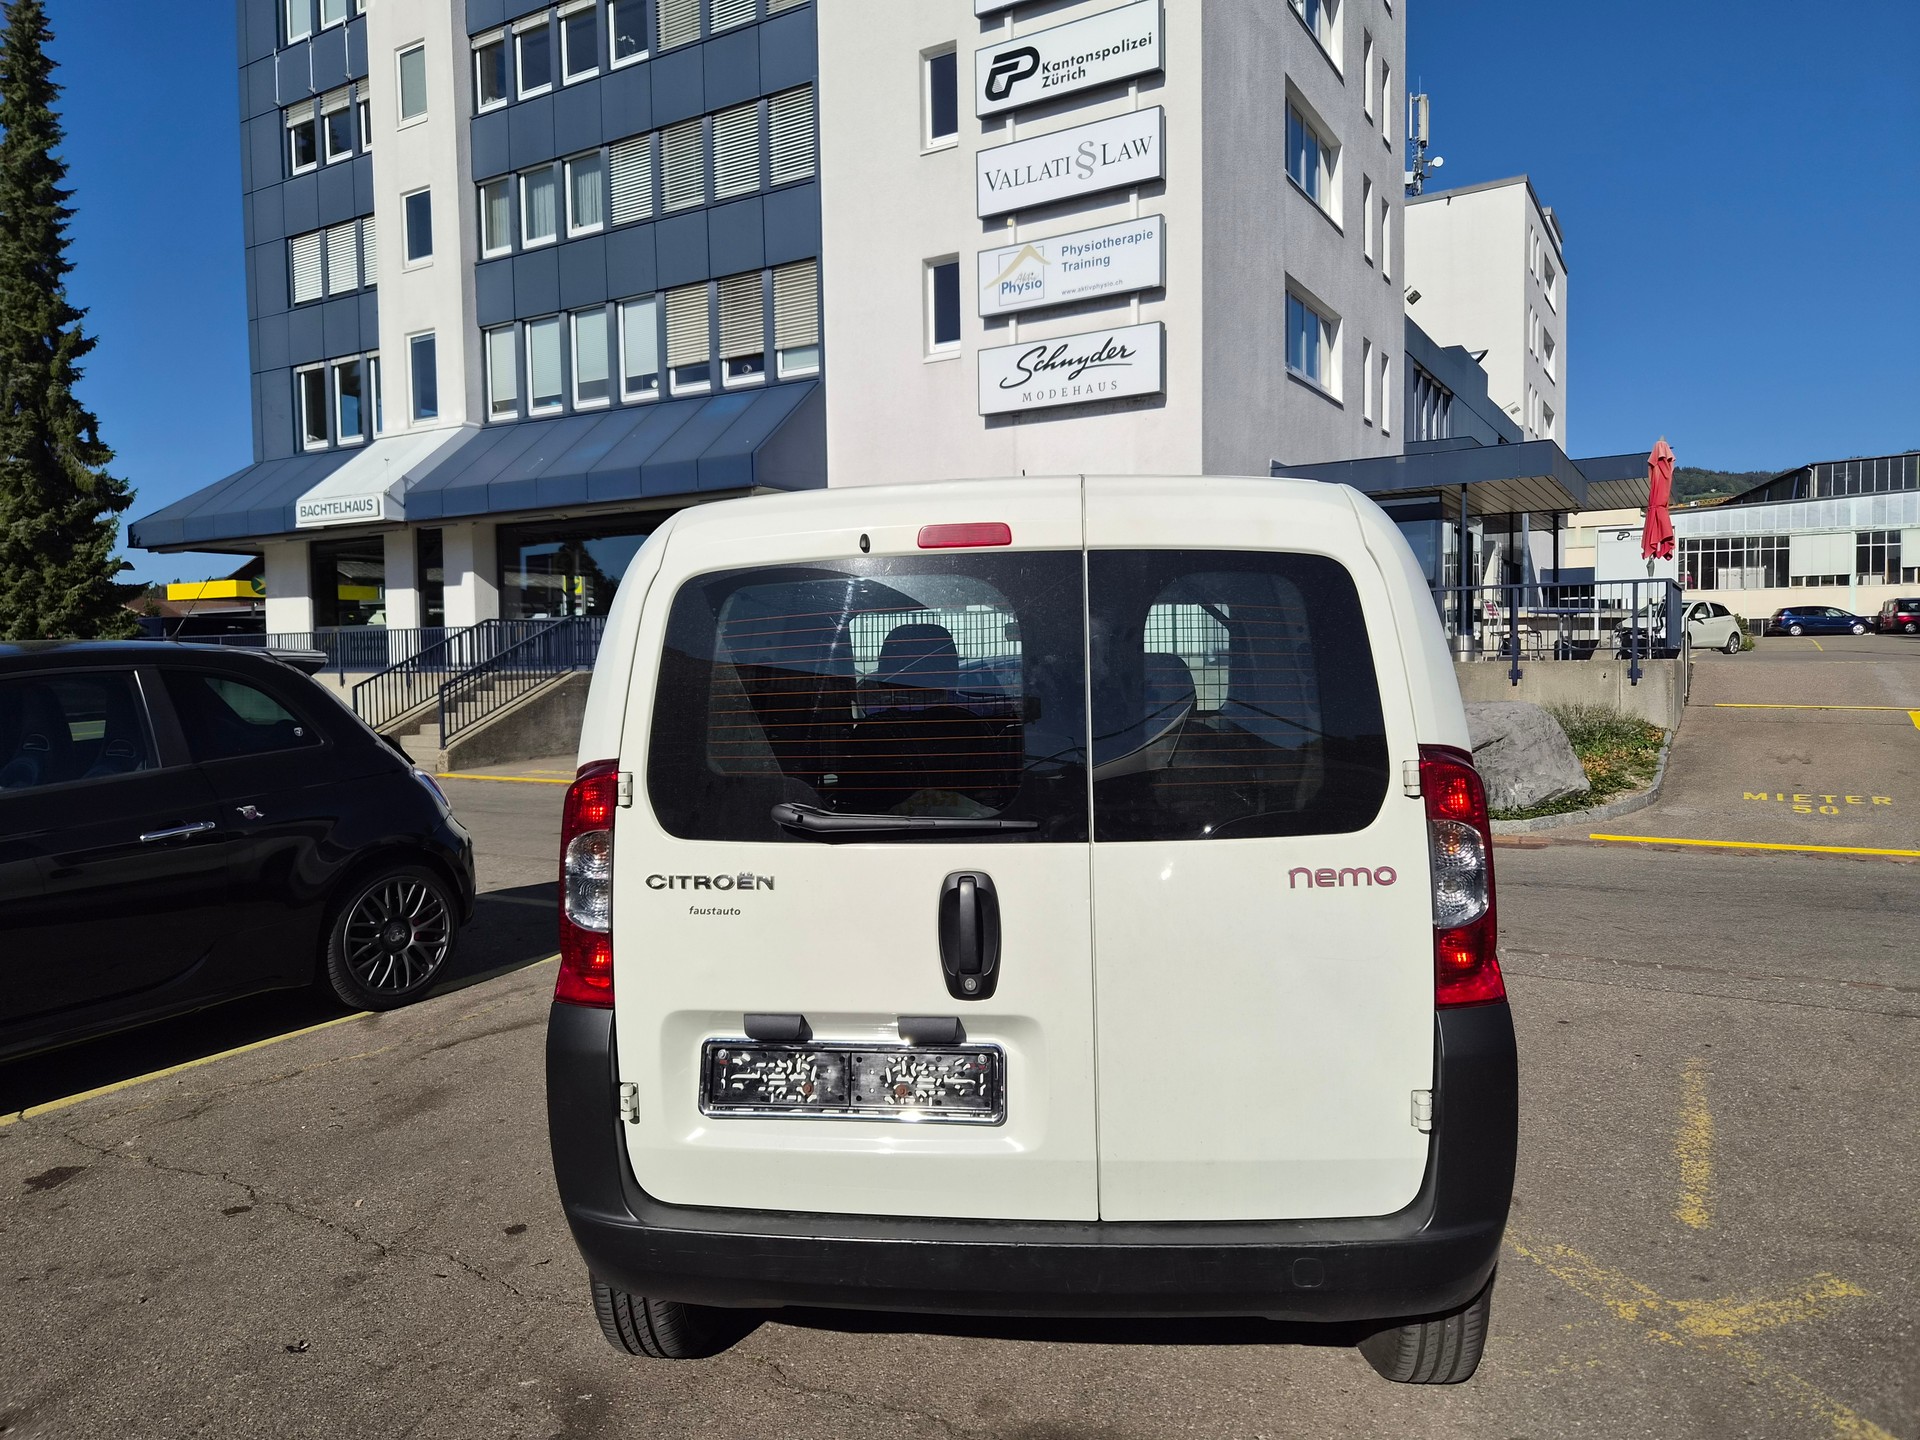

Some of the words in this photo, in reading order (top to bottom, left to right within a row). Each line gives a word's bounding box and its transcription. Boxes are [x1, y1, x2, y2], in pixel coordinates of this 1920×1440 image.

[1041, 32, 1153, 75] Kantonspolizei
[1041, 66, 1086, 89] Zürich
[984, 156, 1071, 192] VALLATI
[1101, 136, 1153, 167] LAW
[1061, 229, 1154, 257] Physiotherapie
[1061, 255, 1111, 273] Training
[1001, 279, 1043, 296] Physio
[1061, 279, 1124, 296] www.aktivphysio.ch
[999, 336, 1137, 390] Schnyder
[1022, 380, 1119, 403] MODEHAUS
[300, 499, 374, 518] BACHTELHAUS
[1743, 792, 1893, 806] MIETER
[1792, 804, 1840, 815] 50
[645, 871, 775, 891] CITROËN
[1288, 866, 1398, 889] nemo
[688, 905, 742, 916] faustauto
